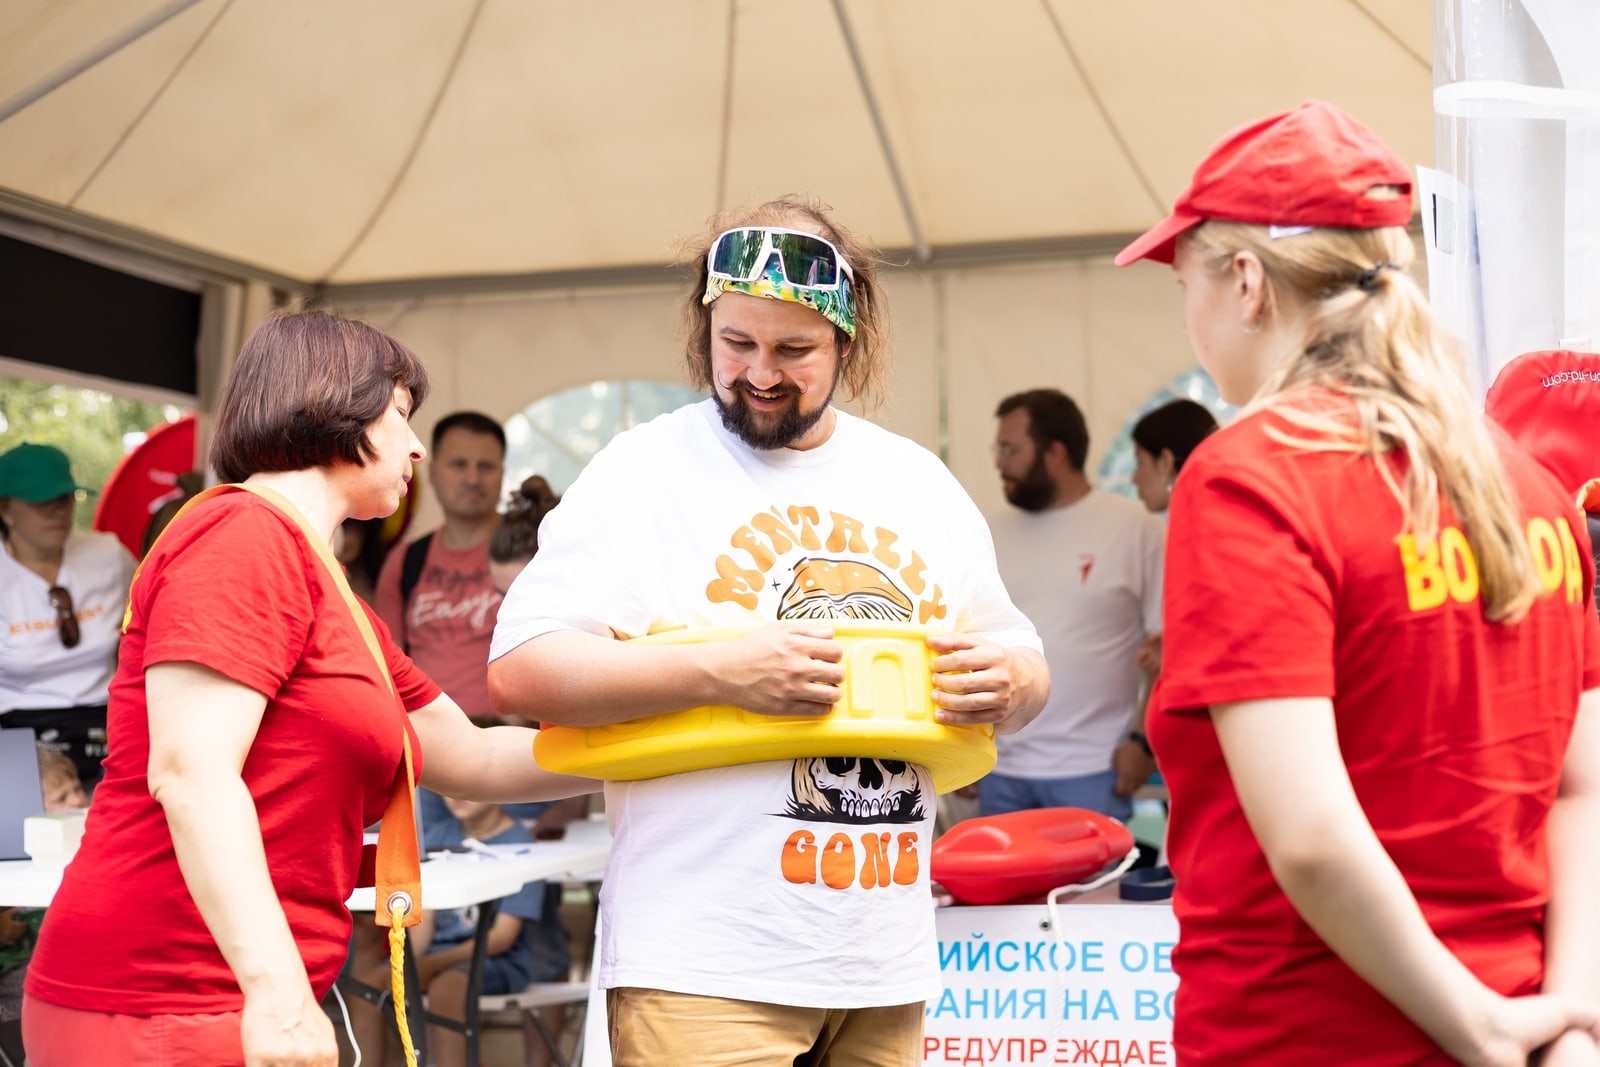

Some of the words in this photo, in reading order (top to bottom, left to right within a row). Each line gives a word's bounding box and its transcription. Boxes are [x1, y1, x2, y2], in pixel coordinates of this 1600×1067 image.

[706, 504, 947, 625] MENTALLY
[781, 829, 919, 890] GONE
[926, 988, 1046, 1020] АНИЯ
[1064, 989, 1119, 1021] НА
[924, 1037, 1175, 1066] РЕДУПРЕЖДАЕ
